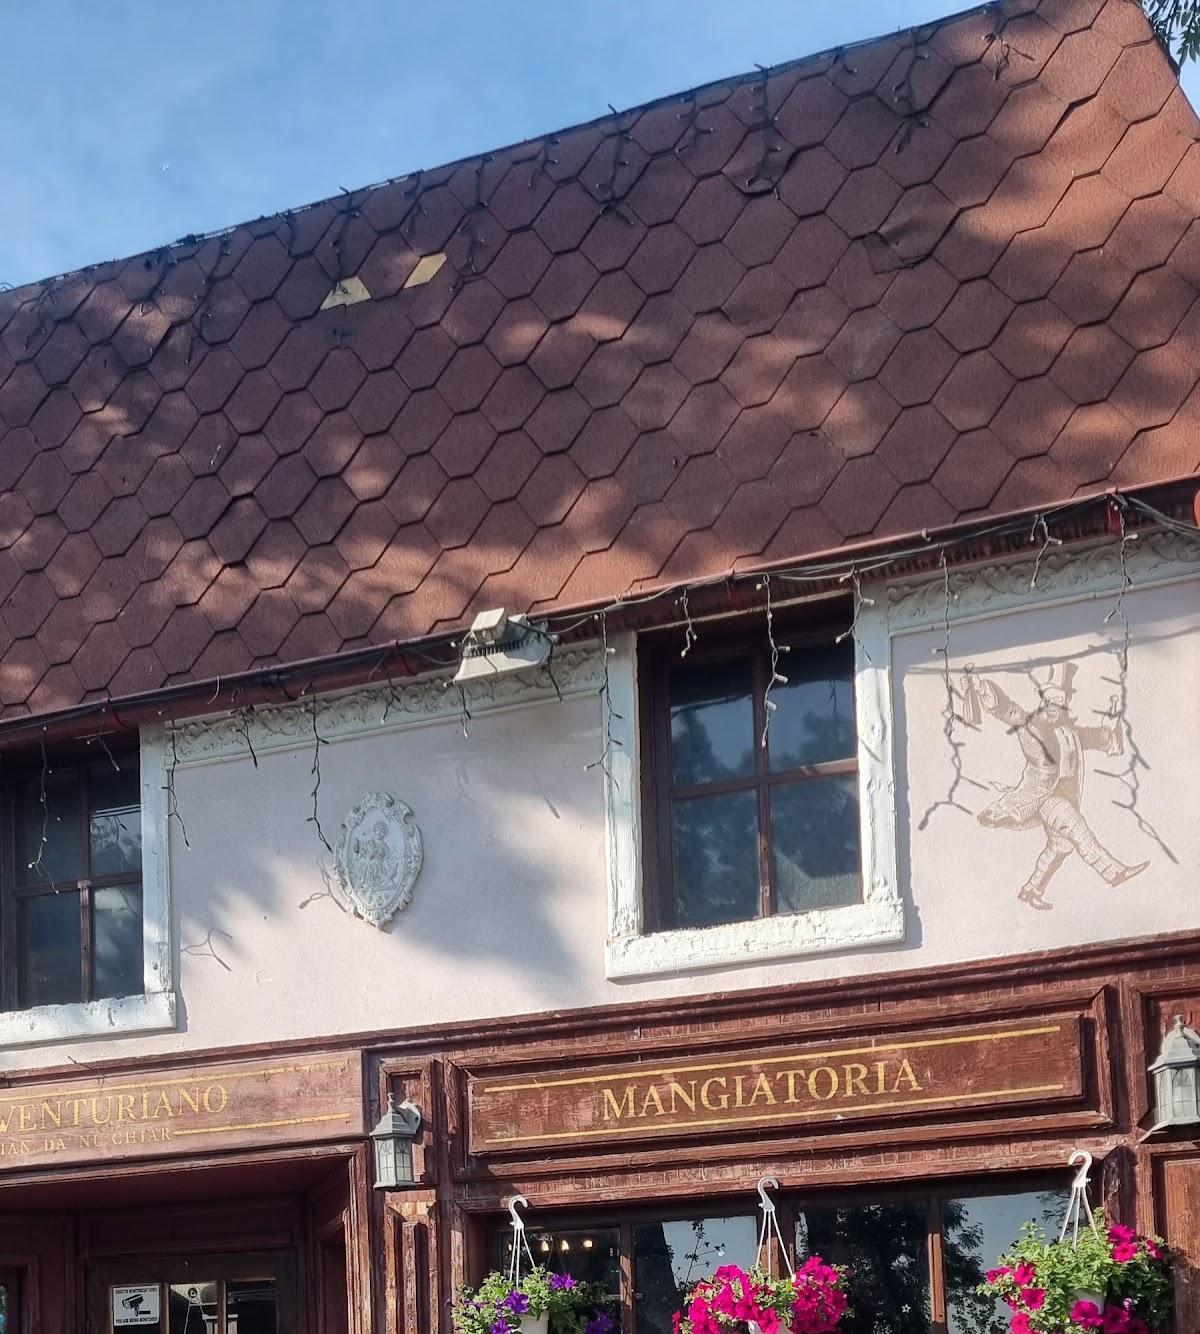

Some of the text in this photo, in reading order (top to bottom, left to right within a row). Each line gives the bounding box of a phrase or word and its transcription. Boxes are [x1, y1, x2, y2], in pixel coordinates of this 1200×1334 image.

[0, 1084, 228, 1133] VENTURIANO
[601, 1058, 923, 1121] MANGIATORIA
[112, 1127, 172, 1145] CHIAR
